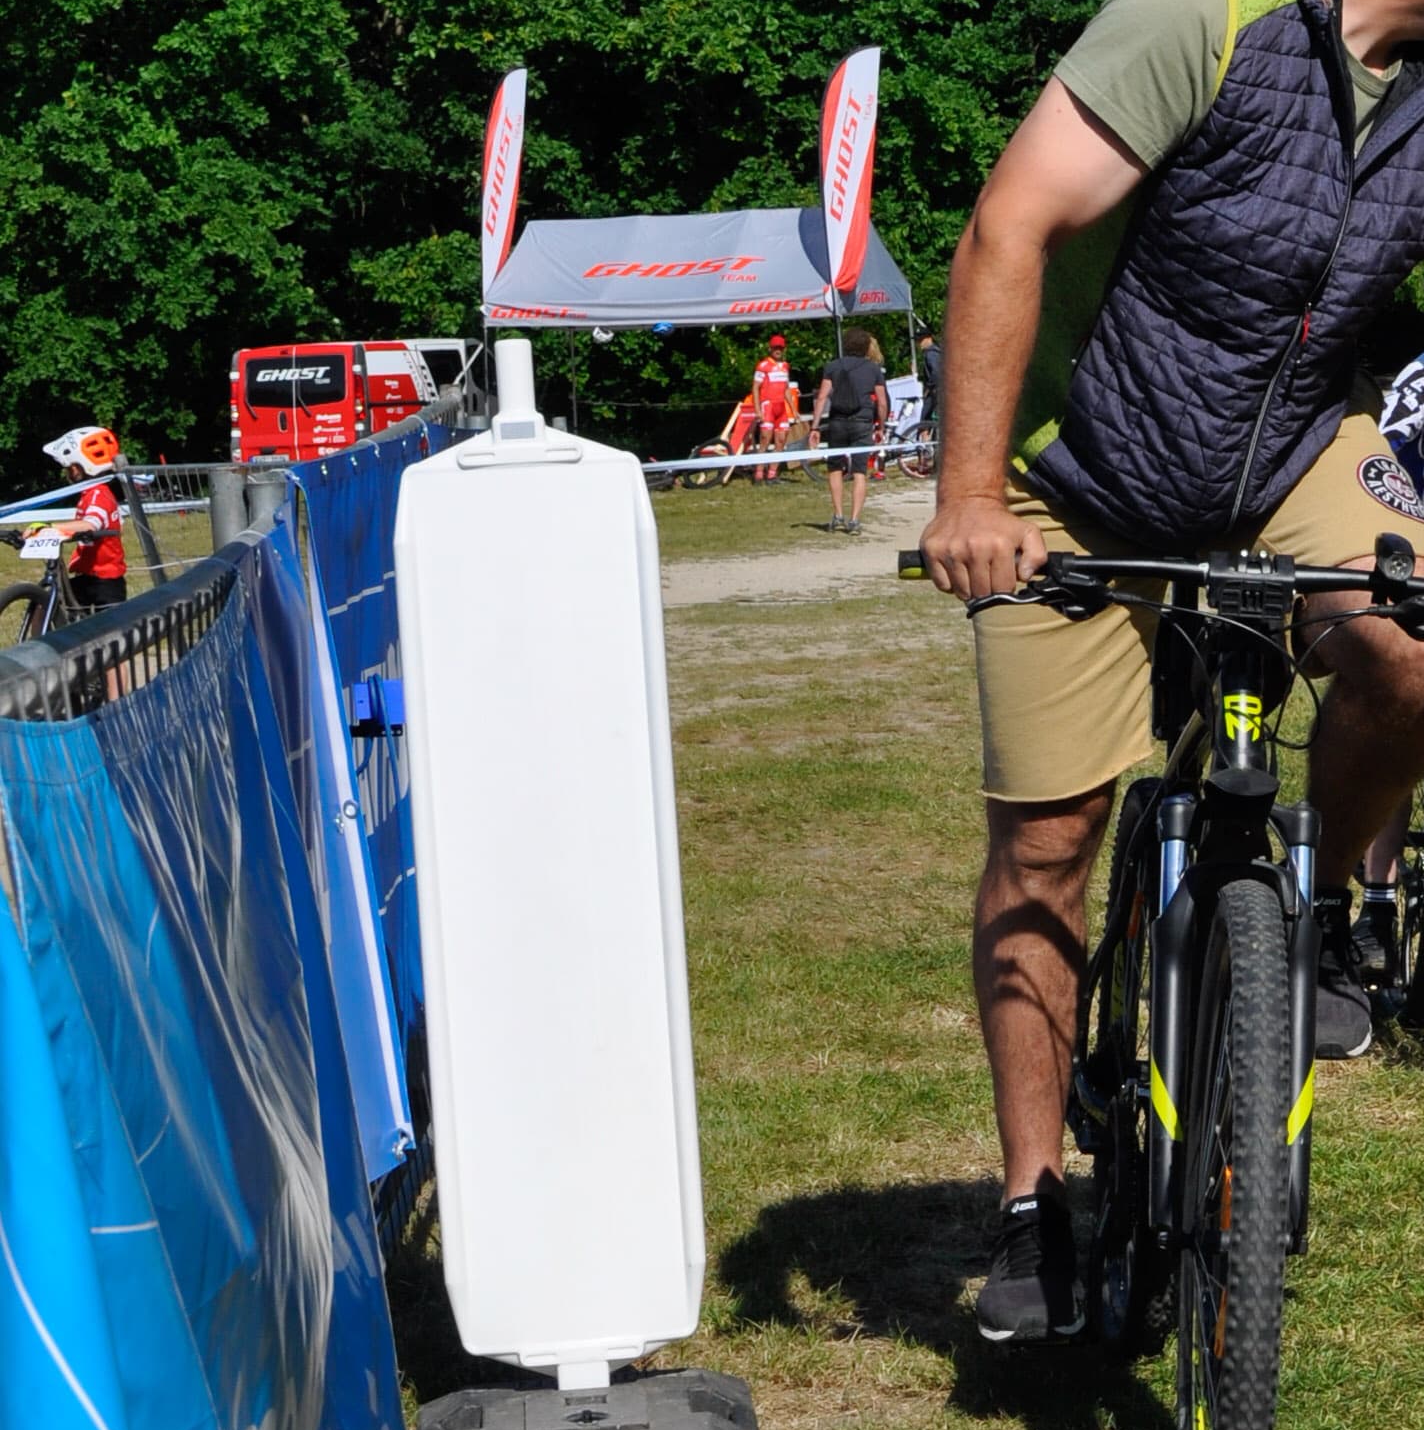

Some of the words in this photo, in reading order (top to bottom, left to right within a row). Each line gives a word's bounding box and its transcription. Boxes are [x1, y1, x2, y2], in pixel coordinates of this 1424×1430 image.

[830, 89, 862, 222] GHOST
[485, 108, 513, 237] GHOST
[582, 255, 767, 279] GHOST
[719, 273, 757, 283] TEAM
[490, 305, 571, 319] GHOST
[728, 298, 816, 315] GHOST
[256, 366, 331, 383] GHOST
